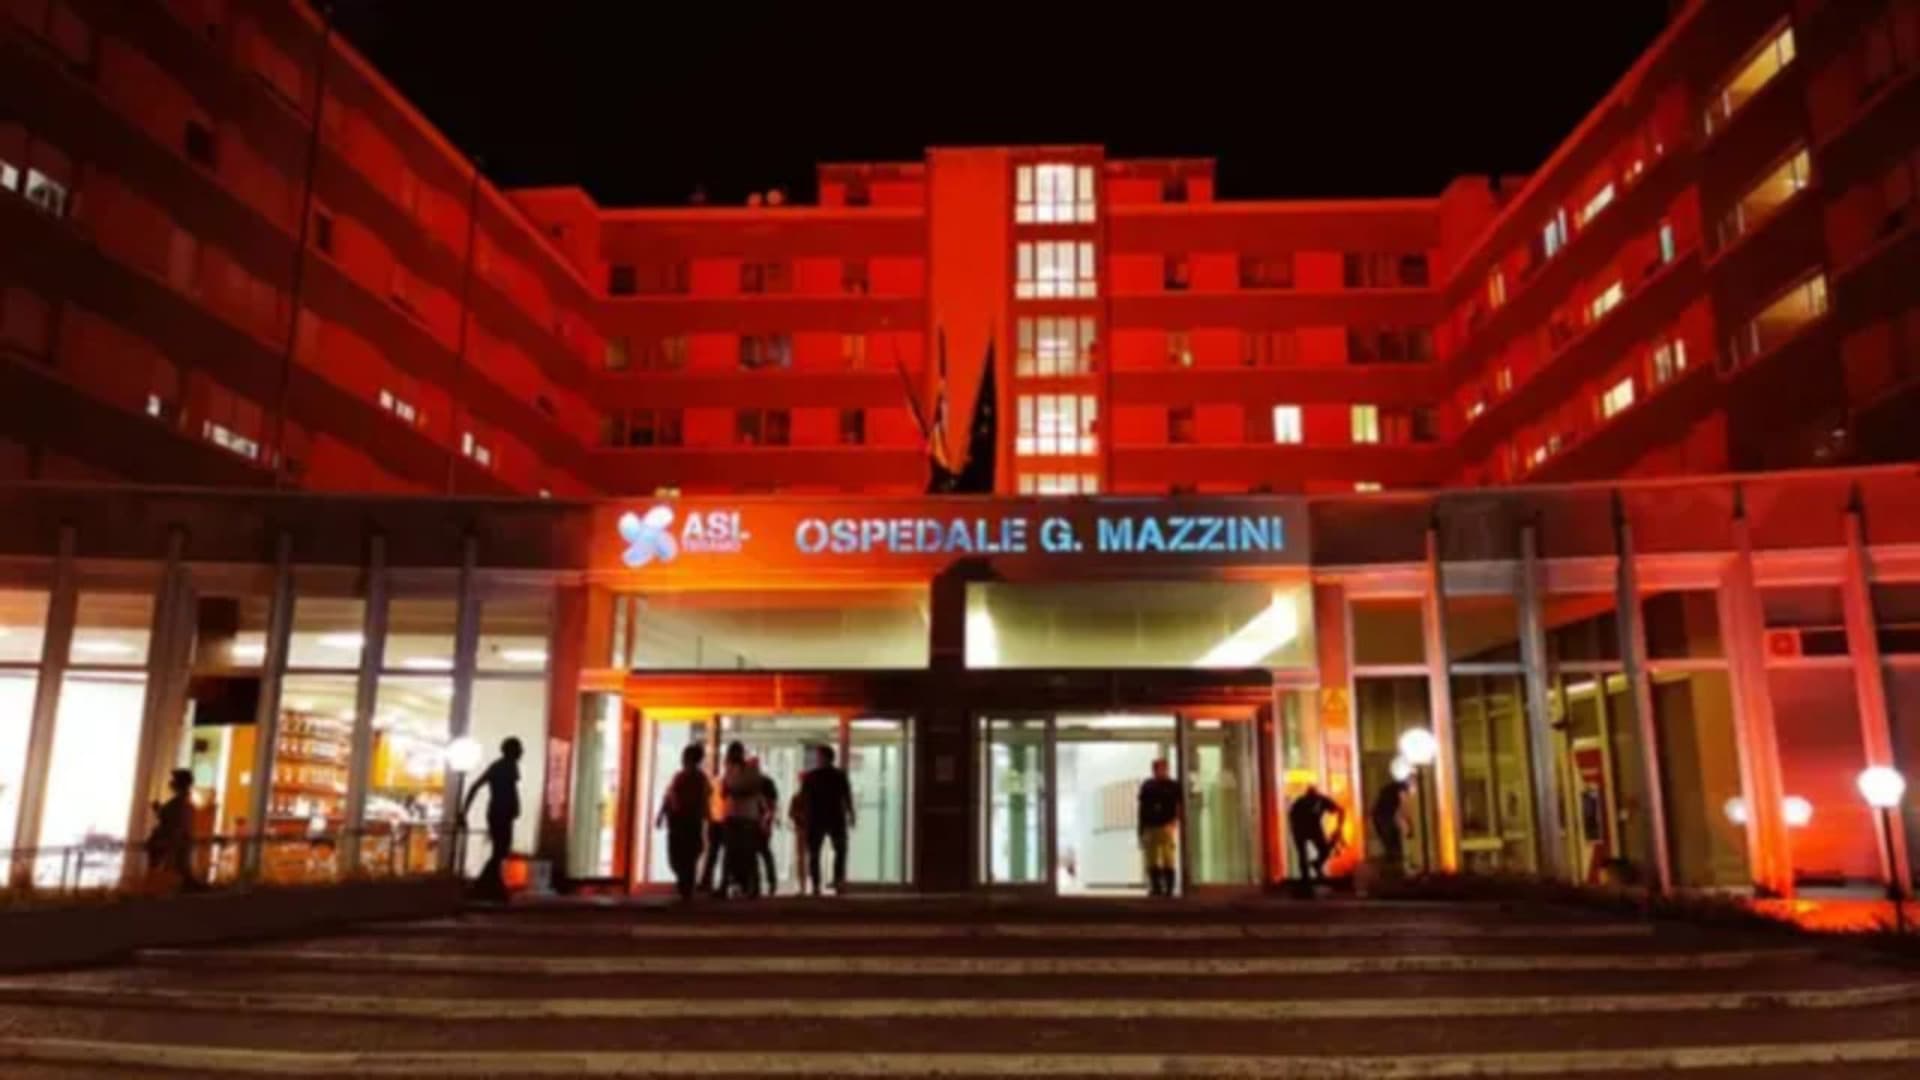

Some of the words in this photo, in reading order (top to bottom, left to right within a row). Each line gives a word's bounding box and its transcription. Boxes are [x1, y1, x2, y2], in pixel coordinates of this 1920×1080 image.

[796, 518, 1027, 552] OSPEDALE
[1040, 517, 1083, 552] G.
[1097, 516, 1283, 552] MAZZINI
